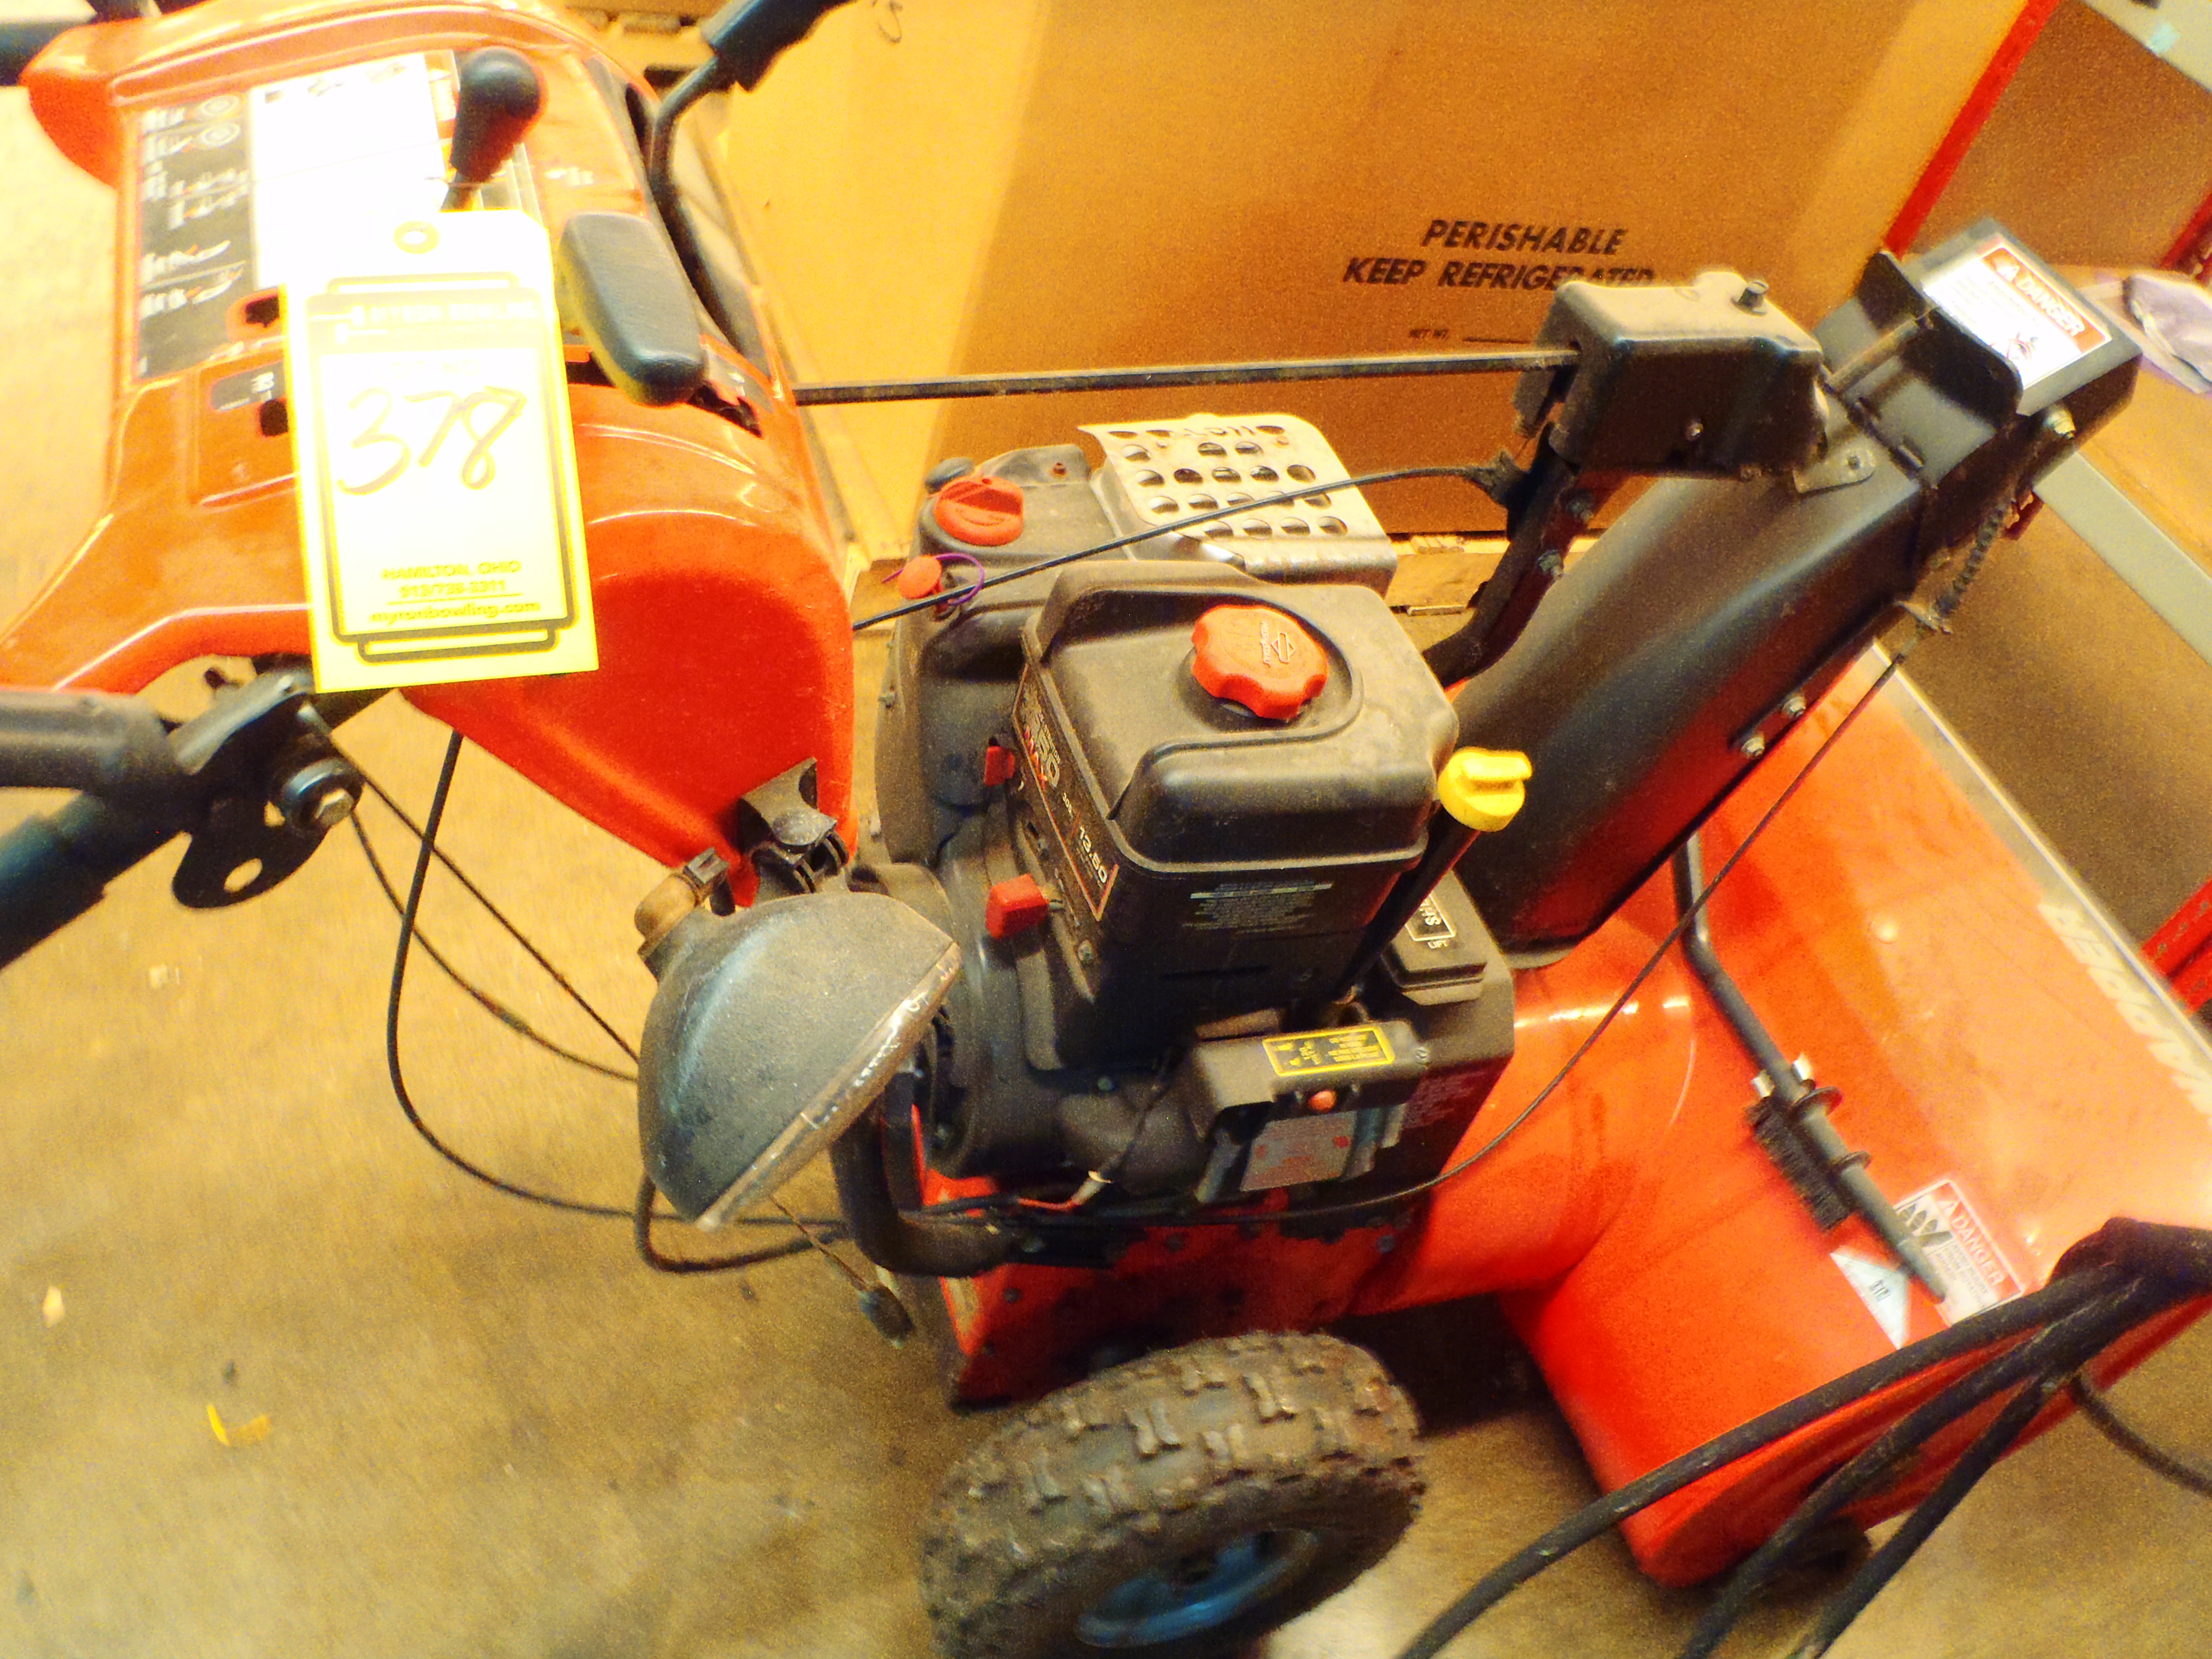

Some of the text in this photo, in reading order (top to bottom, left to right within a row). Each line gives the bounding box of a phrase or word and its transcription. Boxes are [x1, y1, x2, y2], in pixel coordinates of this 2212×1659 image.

[1420, 219, 1629, 256] PERISHABLE
[1342, 257, 1427, 285] KEEP
[2016, 270, 2086, 337] DANGER
[337, 384, 527, 495] 378
[478, 560, 522, 575] OHIO
[1079, 825, 1108, 884] 13.50
[1950, 1214, 2007, 1286] DANGER
